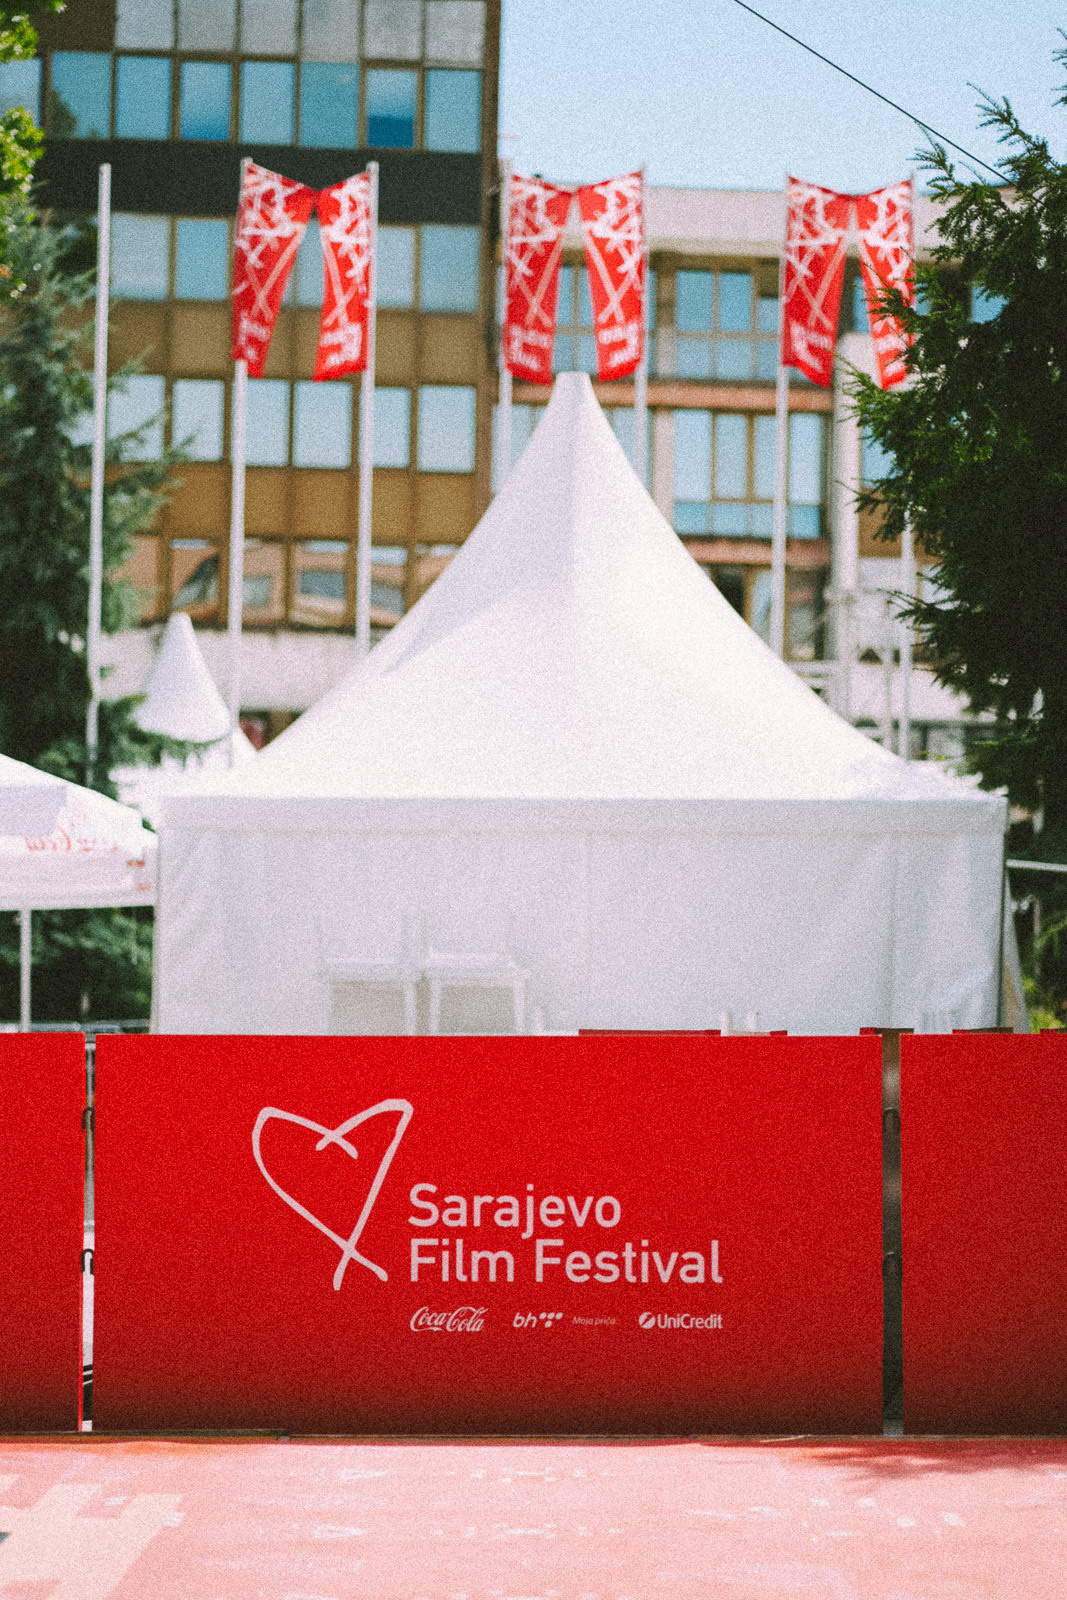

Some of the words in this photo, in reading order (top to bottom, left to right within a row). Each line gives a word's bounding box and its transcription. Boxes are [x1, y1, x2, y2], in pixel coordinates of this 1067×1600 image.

[408, 1183, 621, 1239] Sarajevo
[410, 1238, 514, 1282] Film
[535, 1238, 723, 1283] Festival
[657, 1313, 723, 1329] UniCredit
